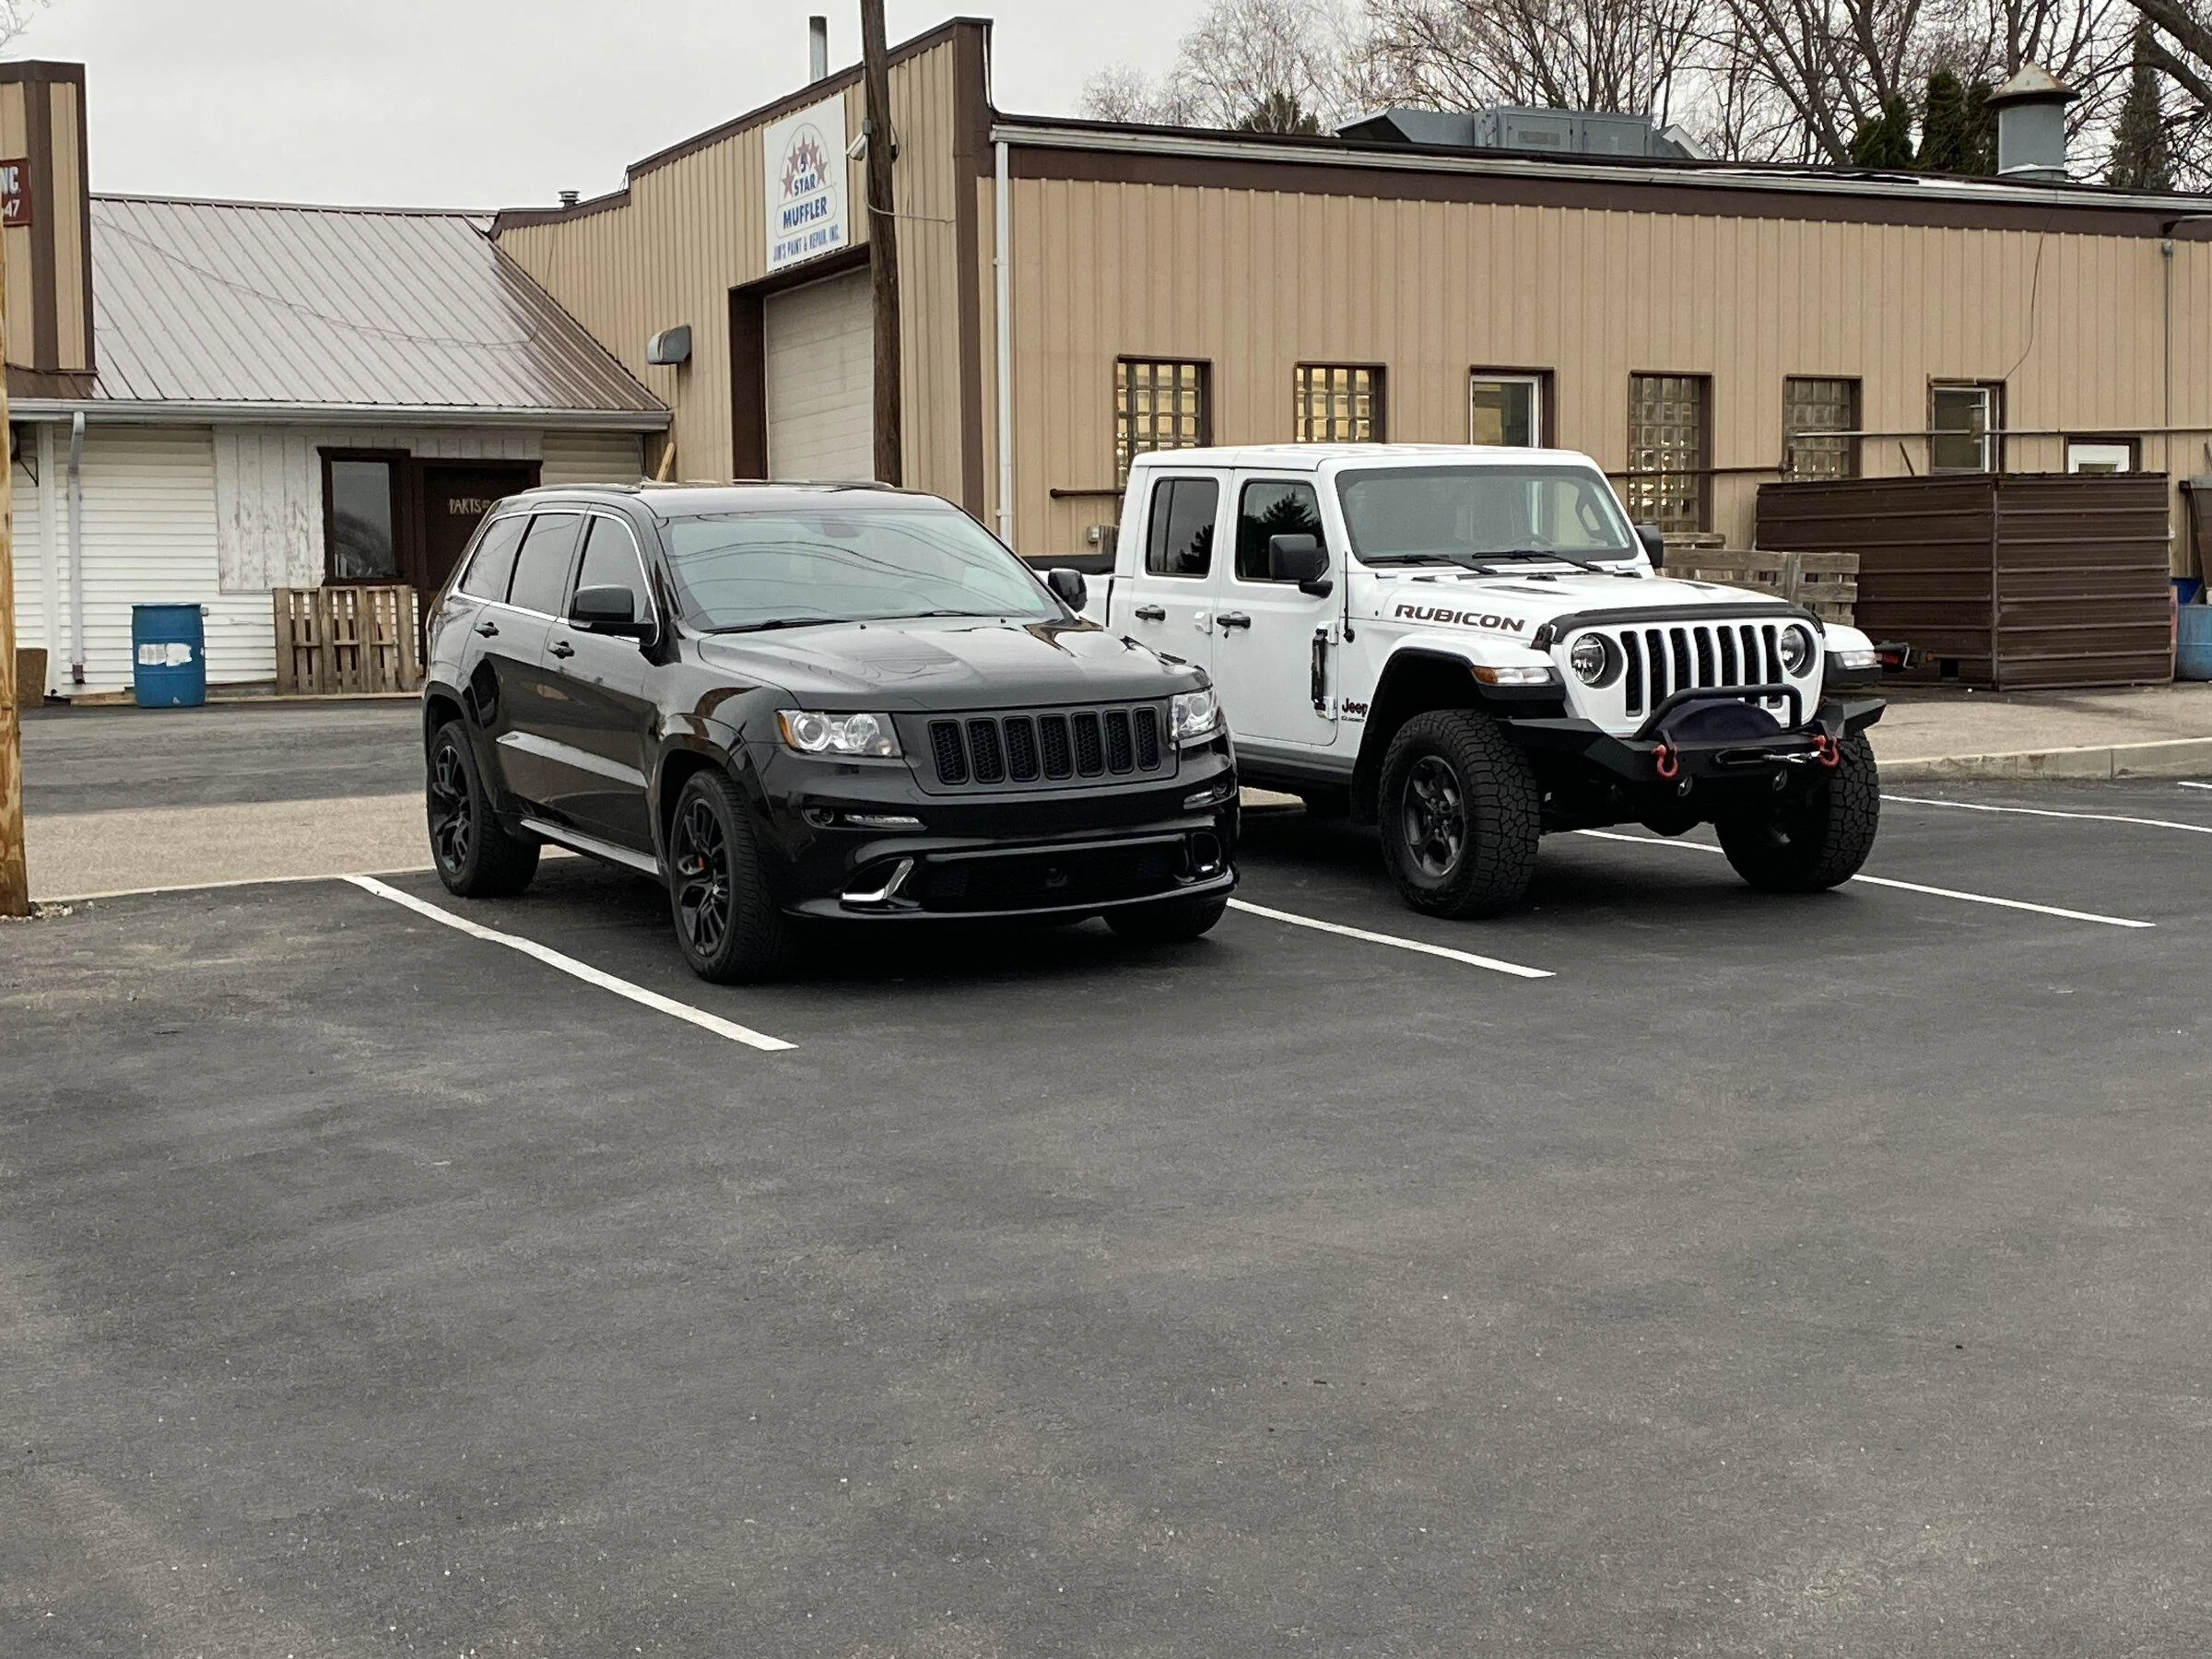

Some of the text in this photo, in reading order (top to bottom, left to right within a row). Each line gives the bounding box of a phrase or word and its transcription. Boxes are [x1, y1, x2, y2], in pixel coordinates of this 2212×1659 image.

[801, 152, 807, 173] 5
[794, 173, 816, 196] STAR
[783, 196, 827, 229] MUFFLER
[788, 237, 802, 257] PAINT
[449, 499, 482, 514] PARTS
[1394, 604, 1525, 632] RUBICON
[1342, 697, 1369, 717] Jeep
